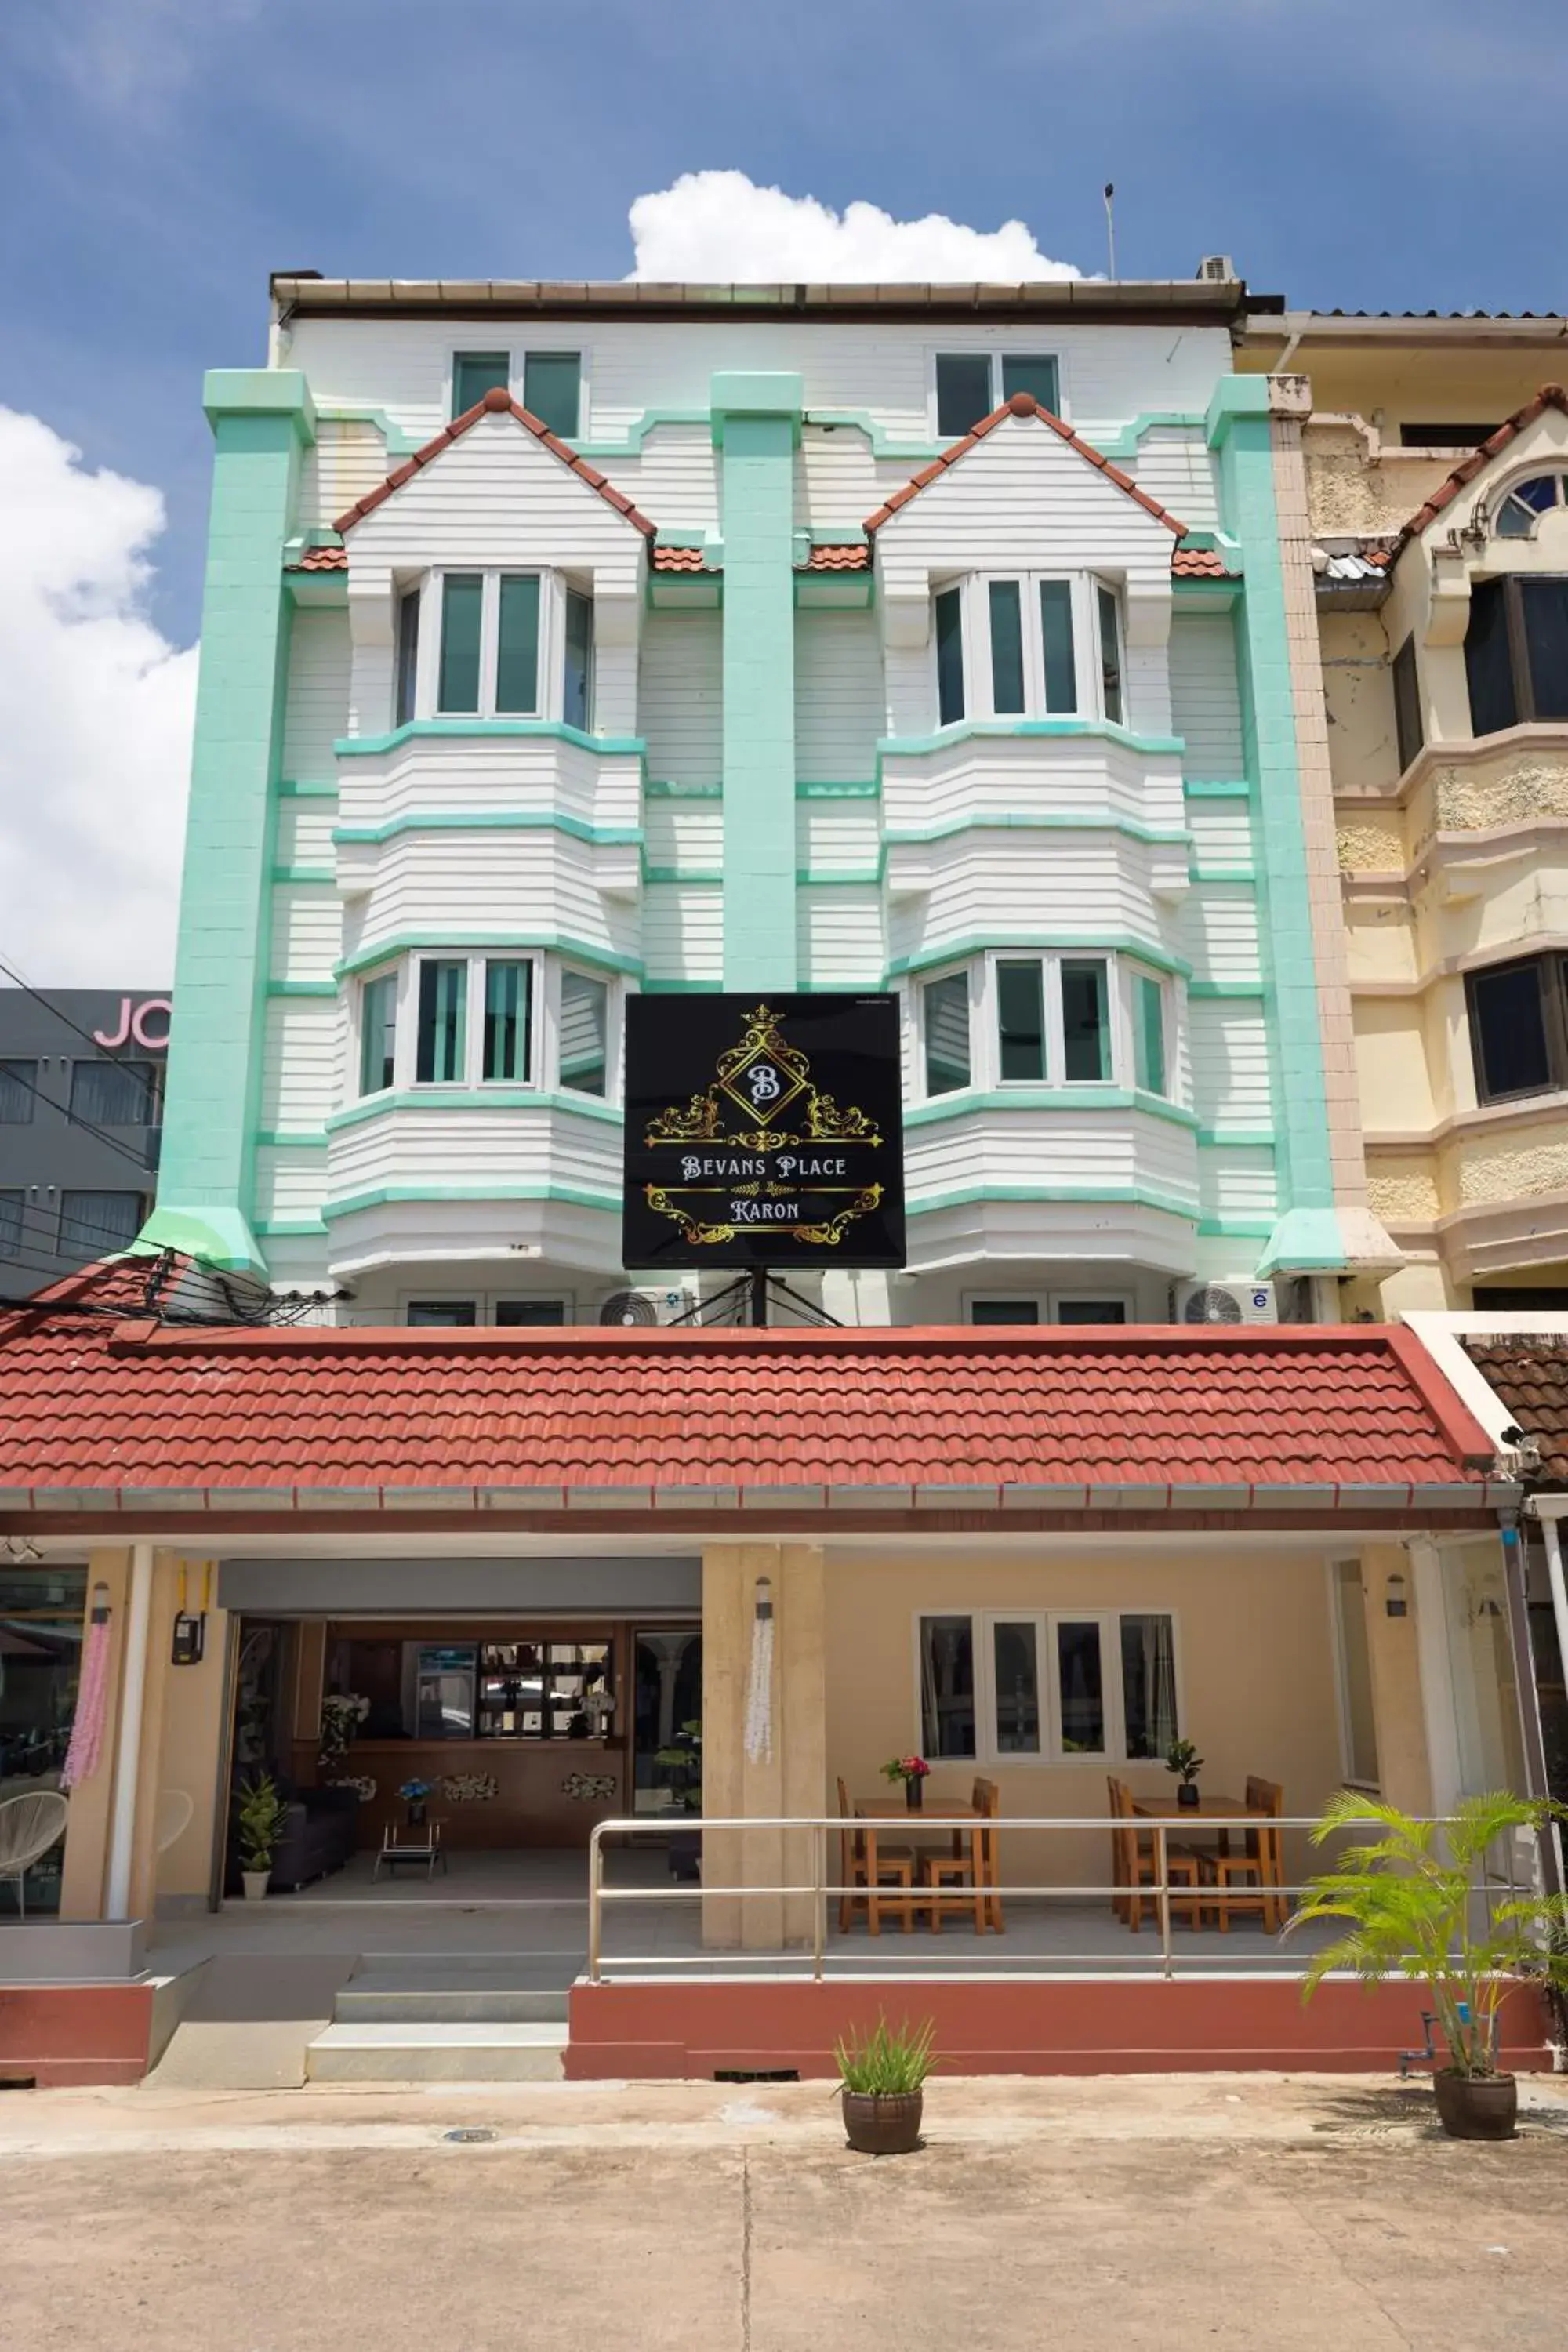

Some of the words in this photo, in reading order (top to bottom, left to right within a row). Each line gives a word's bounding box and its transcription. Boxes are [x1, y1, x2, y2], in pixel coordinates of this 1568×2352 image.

[747, 1065, 780, 1105] B
[681, 1155, 766, 1181] BEVANS
[775, 1155, 846, 1178] PLACE
[730, 1200, 799, 1222] KARON
